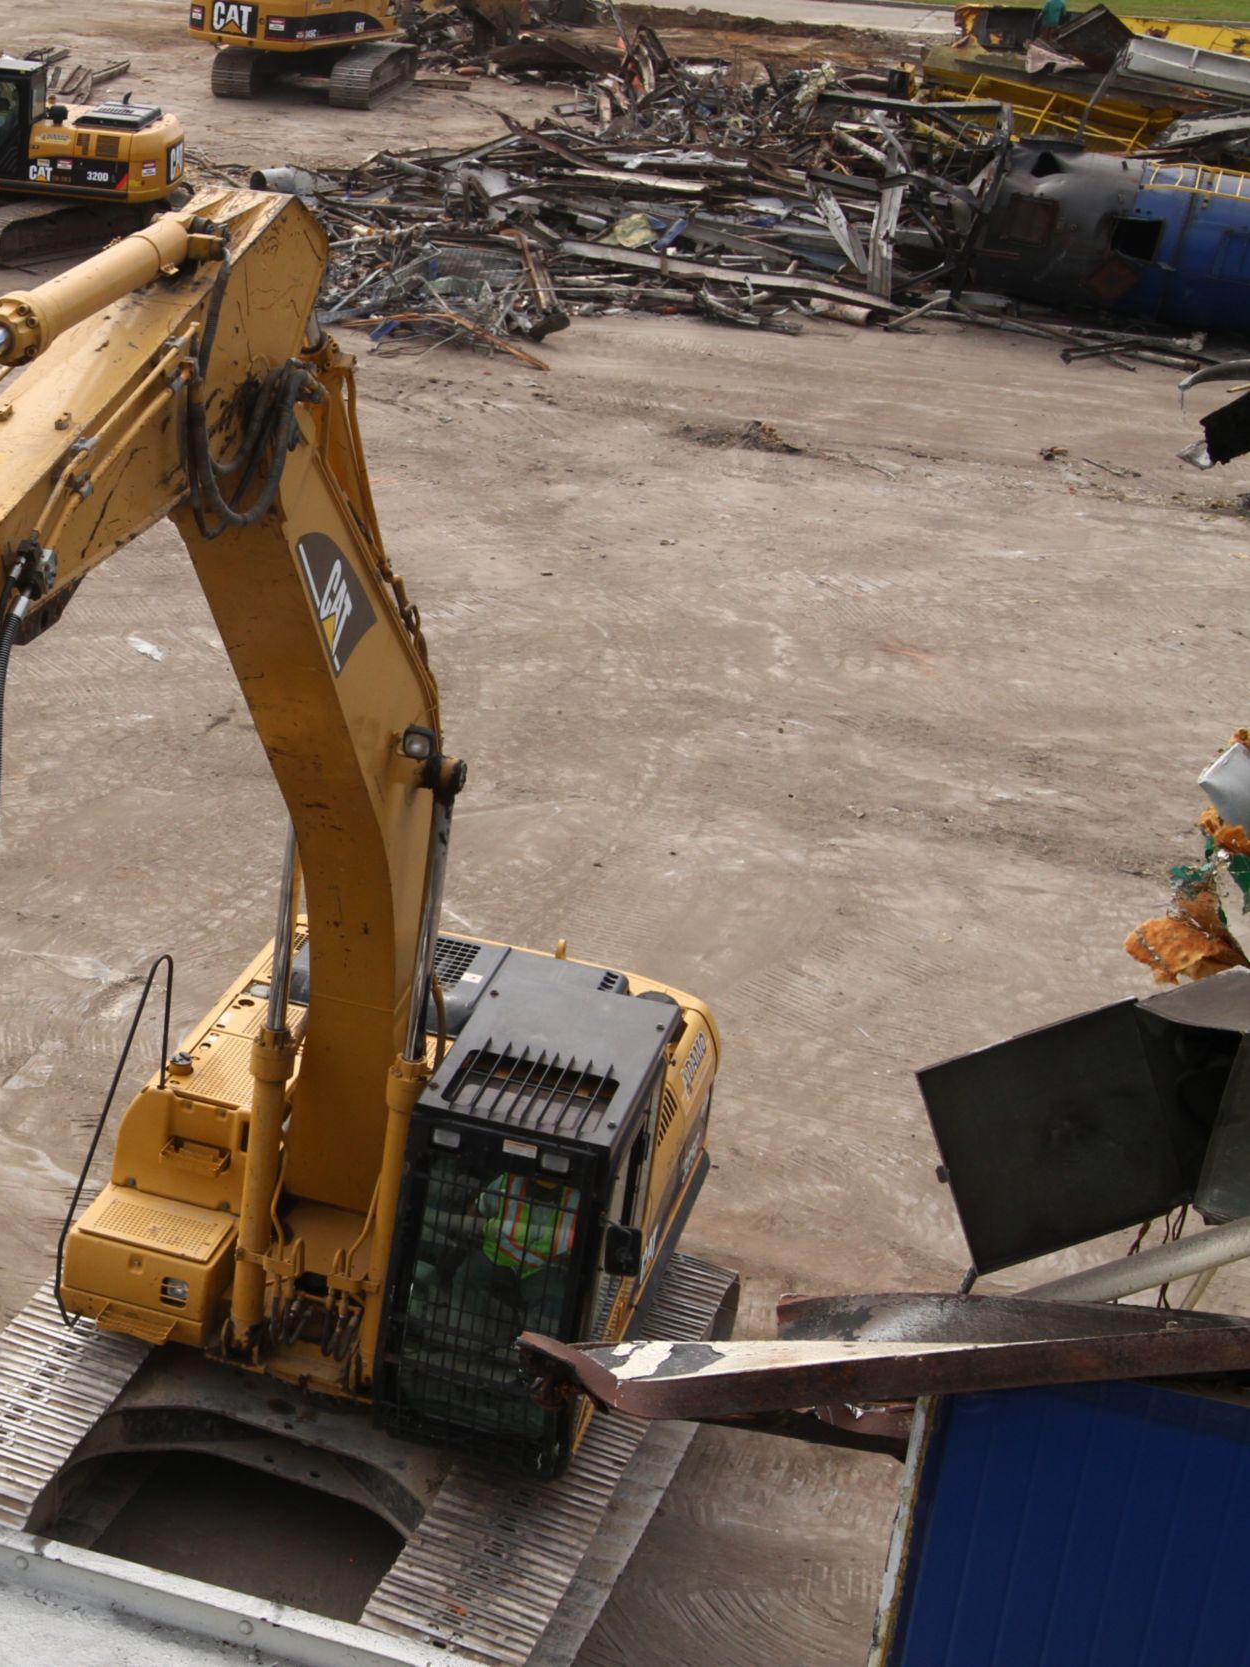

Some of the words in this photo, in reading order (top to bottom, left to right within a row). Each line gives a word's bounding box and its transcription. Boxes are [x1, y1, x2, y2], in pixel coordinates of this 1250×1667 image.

[213, 1, 252, 34] CAT
[29, 165, 53, 182] CAT
[86, 171, 109, 182] 320D
[319, 558, 353, 657] CAT
